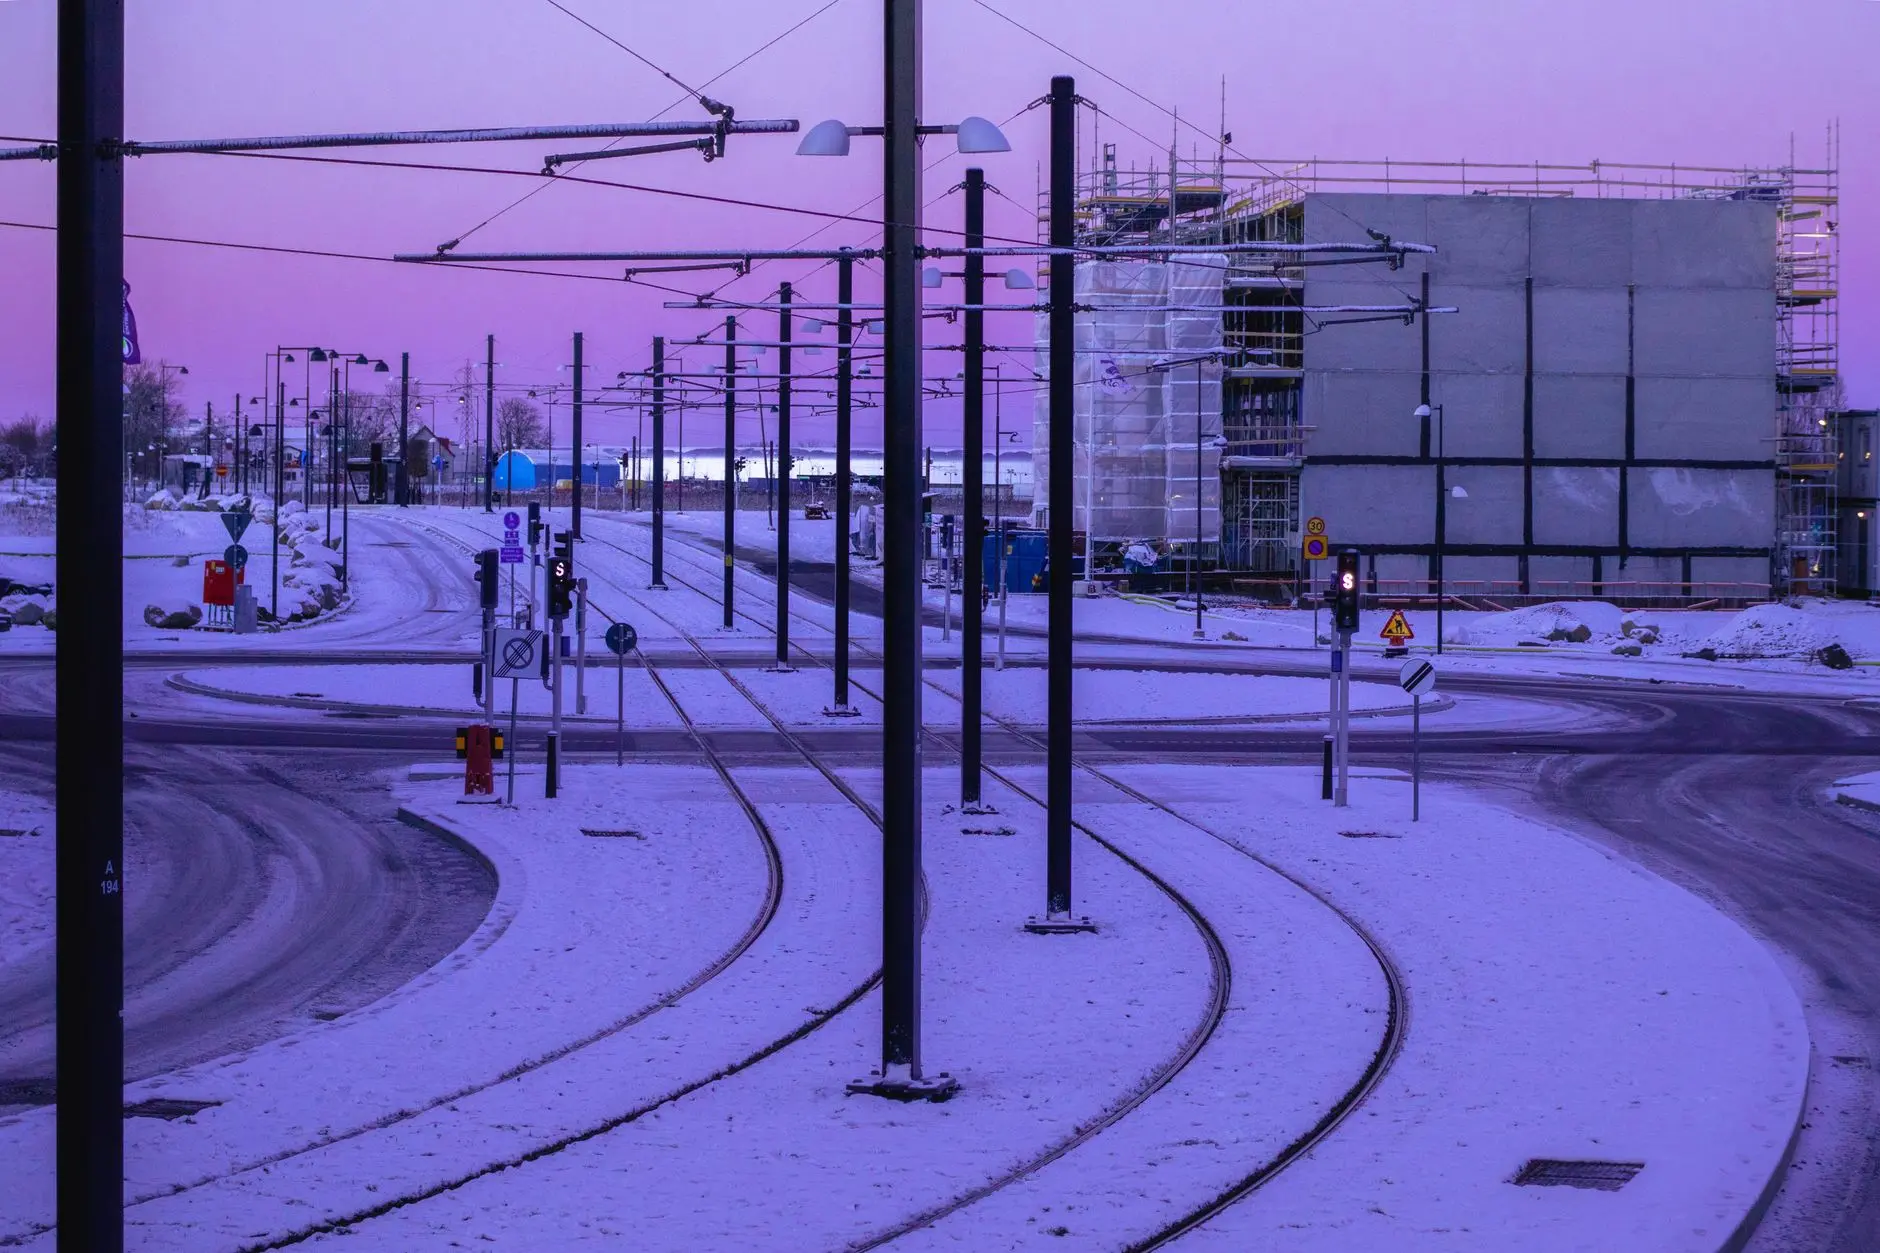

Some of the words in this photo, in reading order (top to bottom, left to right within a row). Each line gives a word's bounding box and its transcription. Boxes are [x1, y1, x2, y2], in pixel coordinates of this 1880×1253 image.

[1310, 521, 1323, 531] 30
[105, 860, 113, 875] A
[101, 879, 119, 894] 194
